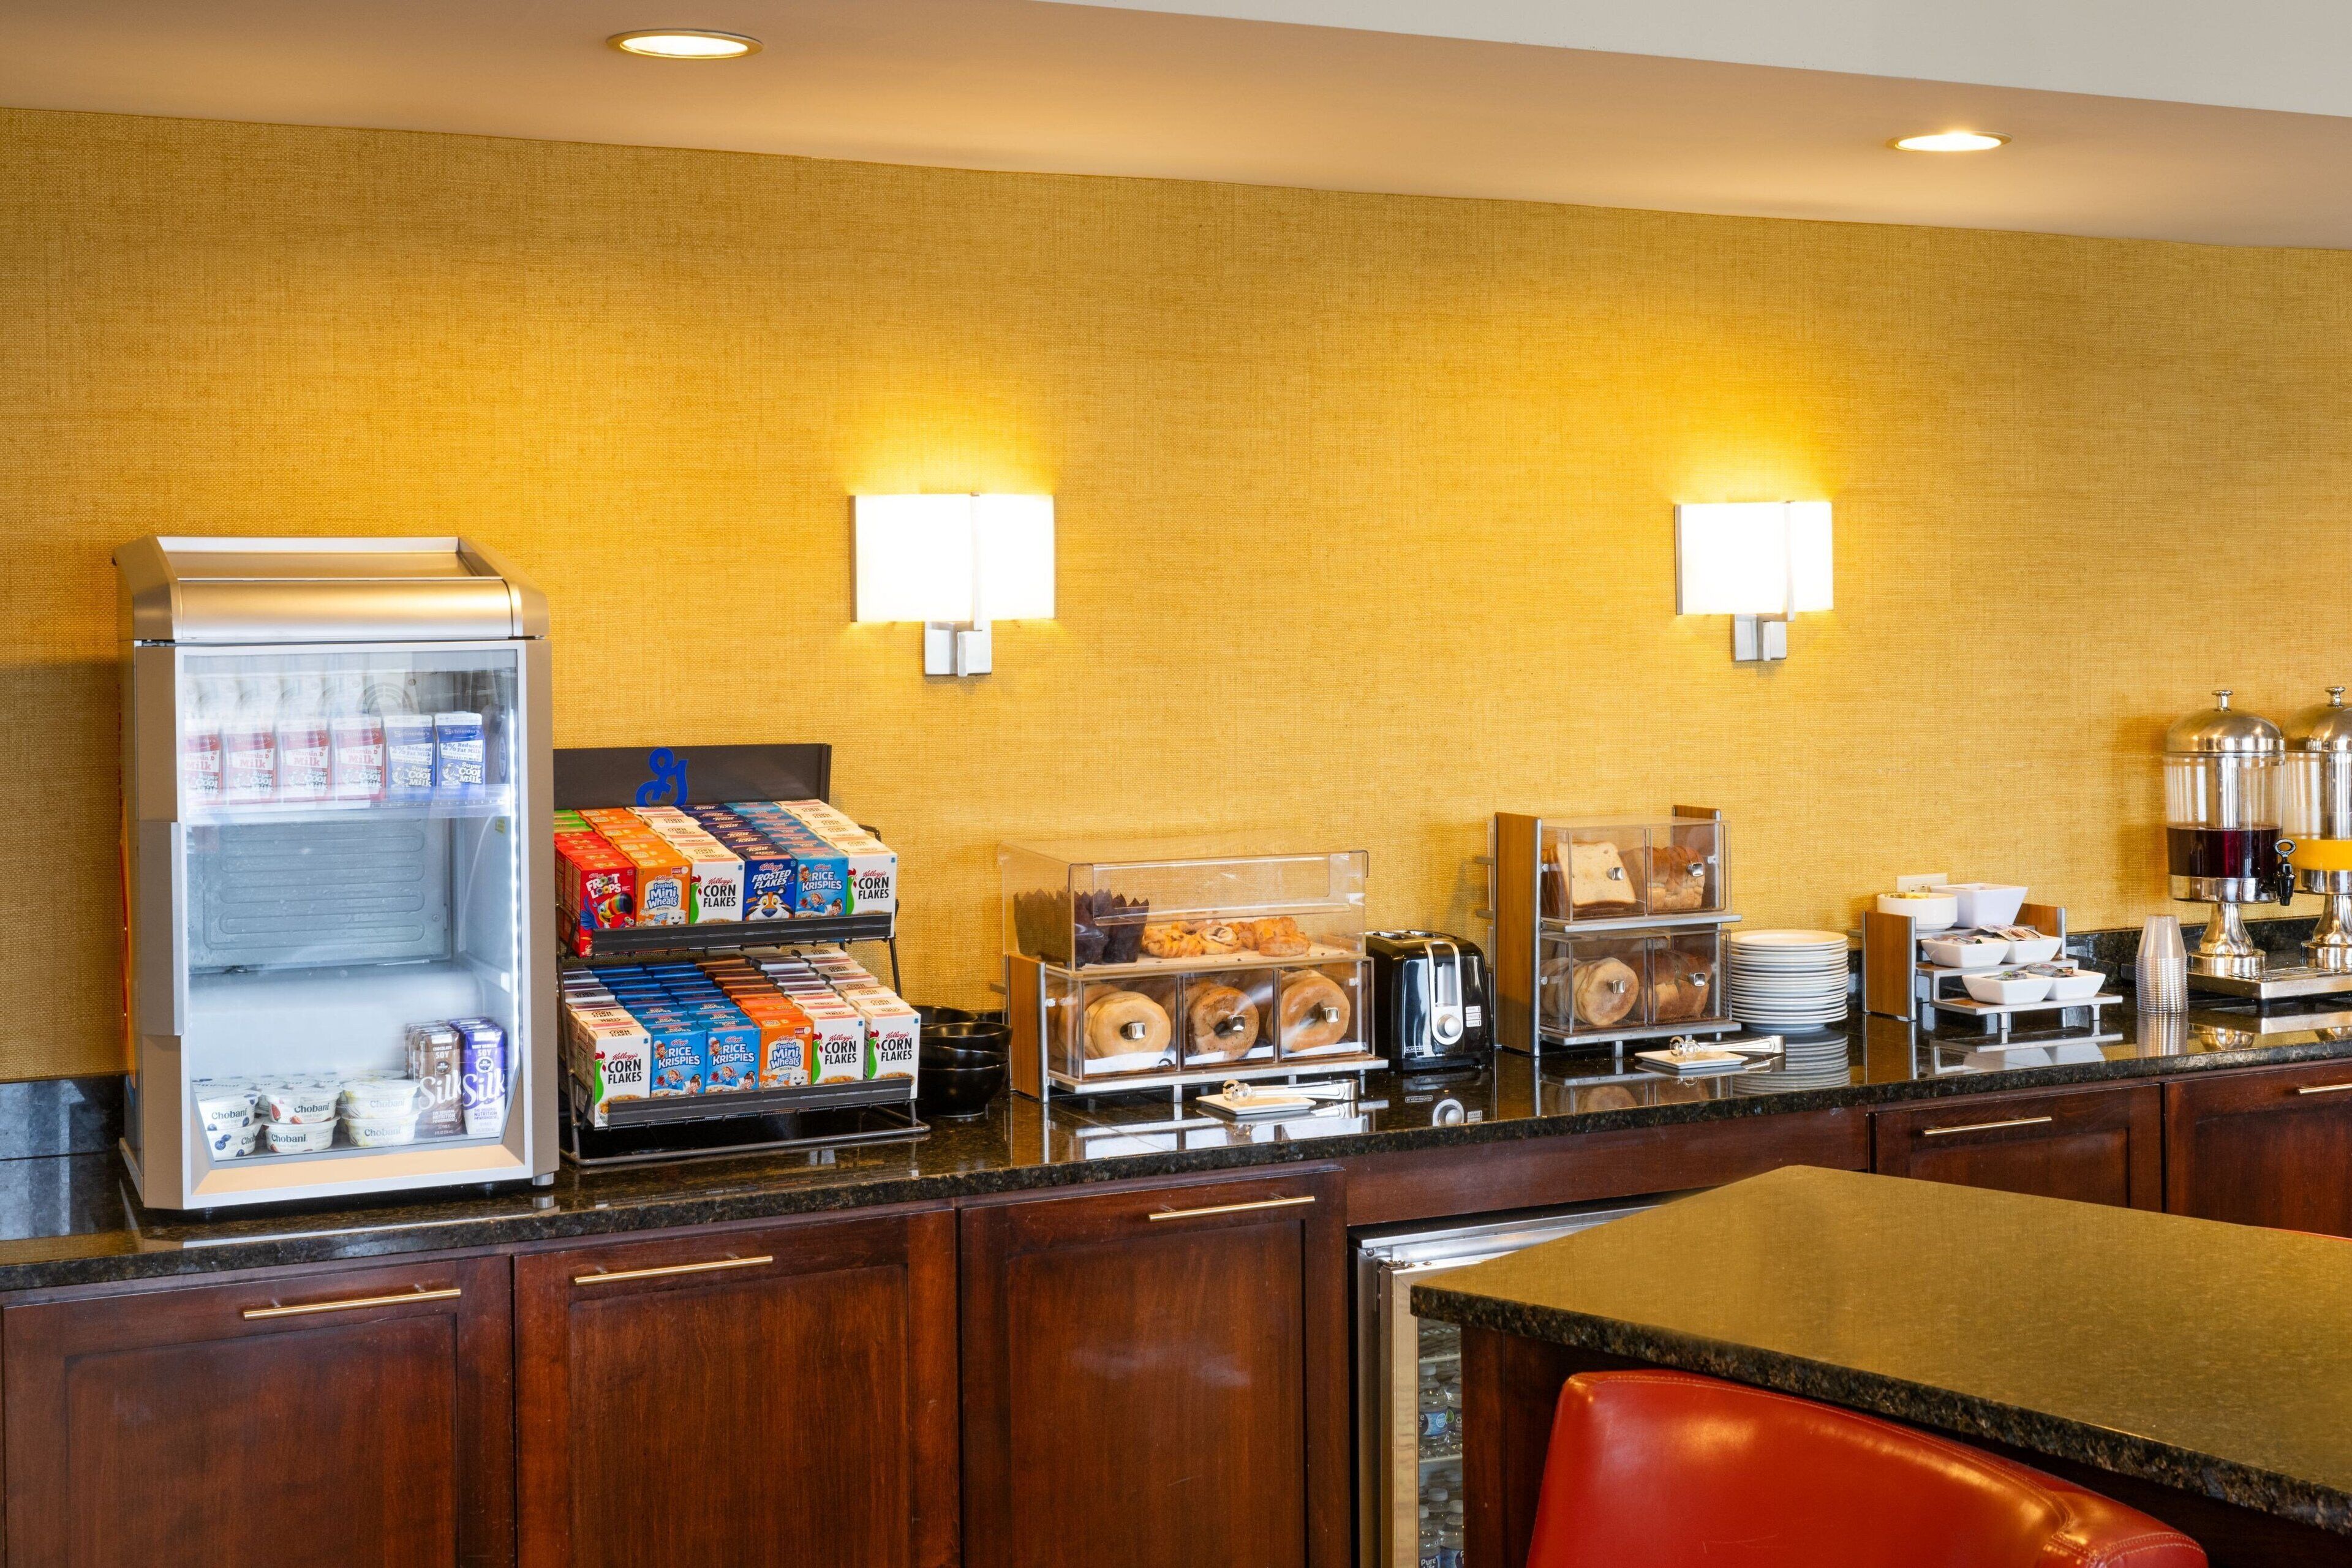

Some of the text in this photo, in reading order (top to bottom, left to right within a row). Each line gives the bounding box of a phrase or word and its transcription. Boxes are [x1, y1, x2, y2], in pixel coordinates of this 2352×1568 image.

[442, 743, 456, 752] 2%
[240, 760, 265, 768] Milk
[294, 757, 320, 766] Milk
[349, 755, 374, 764] Milk
[409, 778, 432, 787] Milk
[459, 775, 483, 785] Milk
[759, 862, 784, 872] Kellogg's
[752, 869, 791, 883] FROSTED
[811, 871, 834, 881] RICE
[862, 869, 886, 878] Kellogg's
[586, 873, 620, 892] FROOT
[708, 877, 734, 886] Kellogg's
[753, 876, 788, 889] FLAKES
[802, 880, 842, 892] KRISPIES
[858, 876, 889, 889] CORN
[590, 883, 622, 899] LOOPS
[650, 886, 677, 900] Mini
[703, 884, 736, 897] CORN
[858, 889, 889, 900] FLAKES
[647, 896, 678, 910] Wheats
[703, 897, 736, 907] FLAKES
[829, 1033, 853, 1042] Kellogg's
[886, 1031, 909, 1039] Kellogg's
[723, 1044, 747, 1054] RICE
[824, 1041, 856, 1054] CORN
[881, 1038, 912, 1051] CORN
[612, 1052, 639, 1061] Kellogg's
[668, 1047, 692, 1058] RICE
[773, 1047, 800, 1060] Mini
[881, 1050, 912, 1061] FLAKES
[658, 1055, 701, 1069] KRISPIES
[712, 1053, 755, 1066] KRISPIES
[770, 1057, 801, 1070] Wheats
[824, 1053, 856, 1065] FLAKES
[608, 1059, 641, 1073] CORN
[608, 1072, 642, 1084] FLAKES
[418, 1069, 461, 1110] Silk
[462, 1068, 505, 1107] Silk
[211, 1108, 247, 1120] Chobani
[294, 1102, 330, 1114] Chobani
[364, 1126, 401, 1137] Chobani
[271, 1134, 306, 1144] Chobani
[1421, 1558, 1436, 1566] Pure
